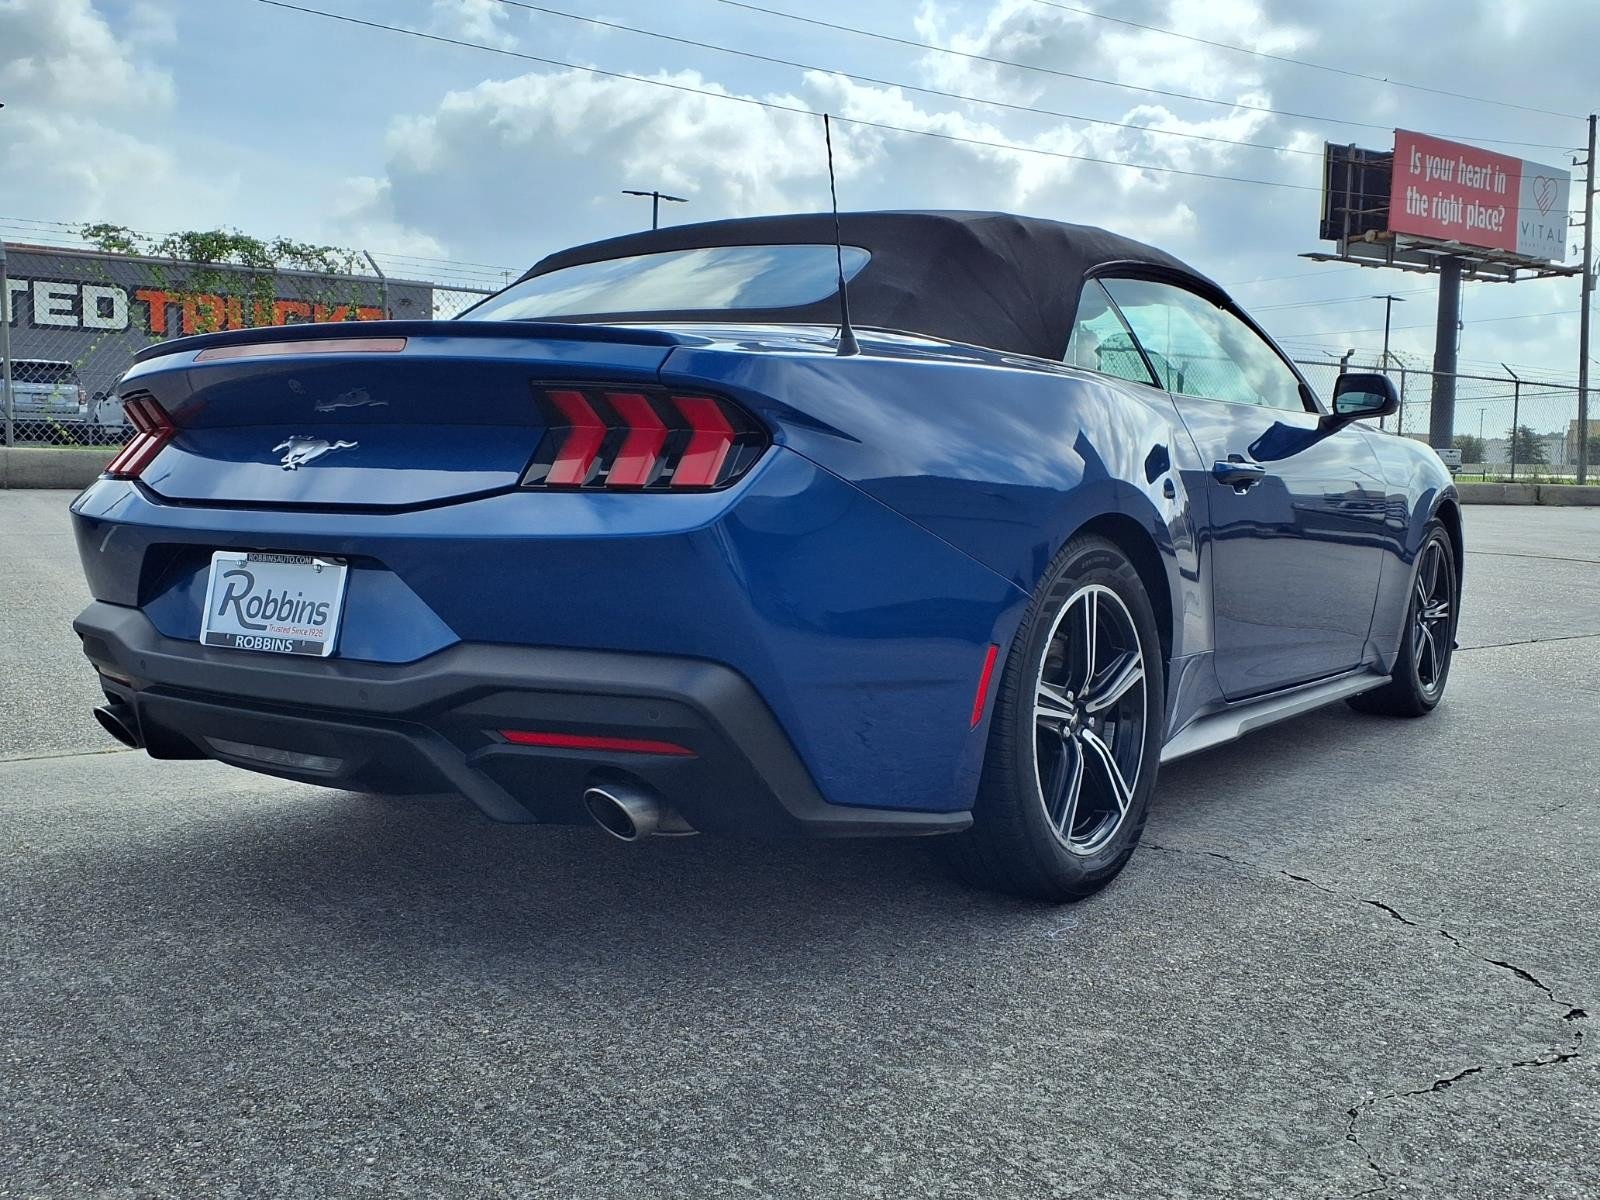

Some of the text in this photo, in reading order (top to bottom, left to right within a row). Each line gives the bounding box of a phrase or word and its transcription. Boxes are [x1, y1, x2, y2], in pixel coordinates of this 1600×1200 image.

[1410, 144, 1507, 195] Is your heart in
[1406, 185, 1506, 232] the right place?
[1521, 220, 1564, 244] VITAL
[248, 553, 312, 564] ROBBINSAUTO.COM
[218, 569, 330, 631] Robbins
[269, 623, 291, 634] Trusted
[291, 626, 308, 636] Since
[235, 635, 294, 652] ROBBINS
